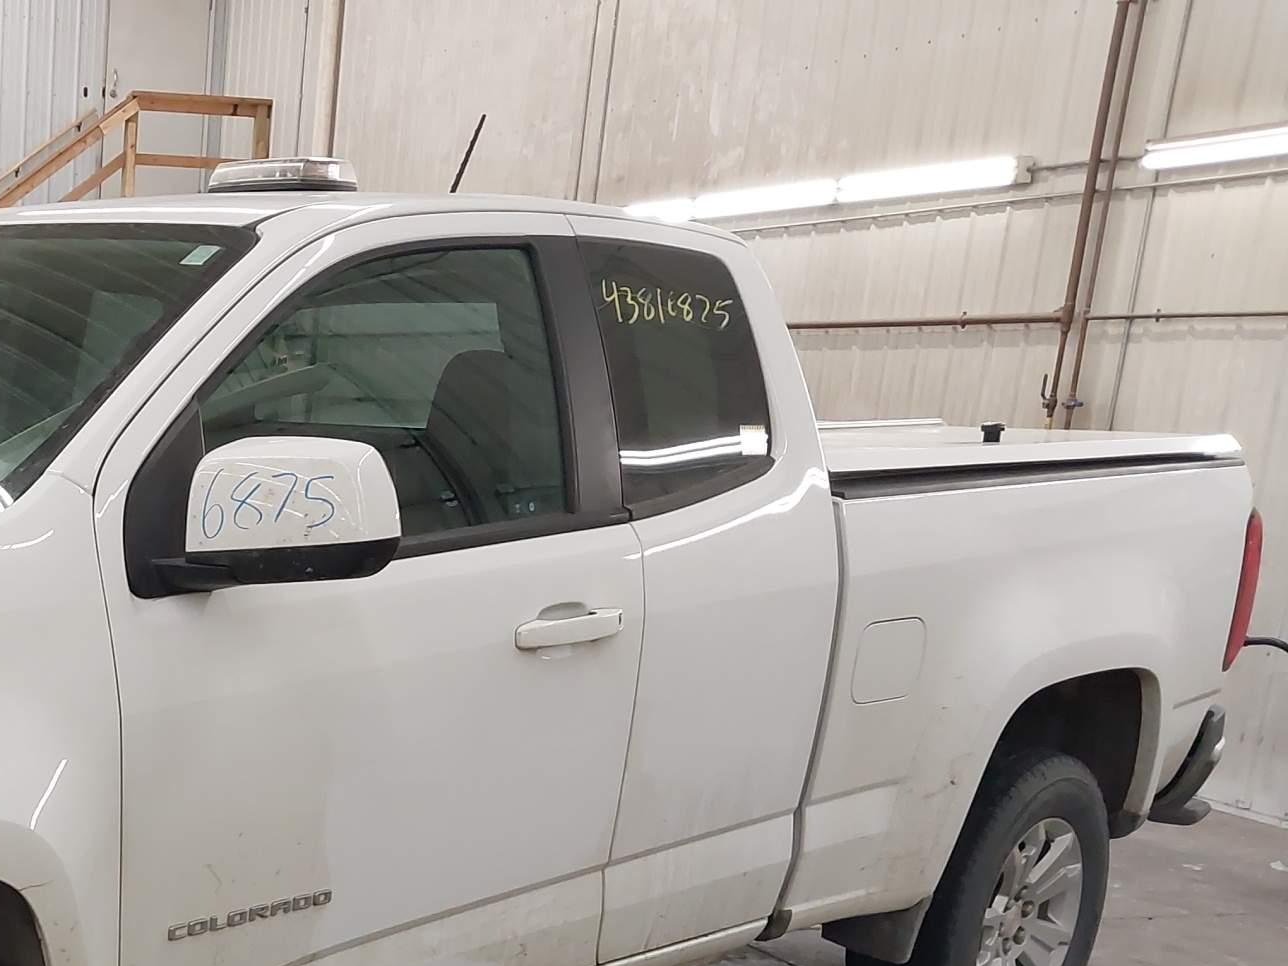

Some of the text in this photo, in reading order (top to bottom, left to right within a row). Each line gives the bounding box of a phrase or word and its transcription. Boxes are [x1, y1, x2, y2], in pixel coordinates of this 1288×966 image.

[602, 279, 733, 329] 43816875
[202, 468, 335, 539] 6875
[168, 888, 332, 941] COLORADO
